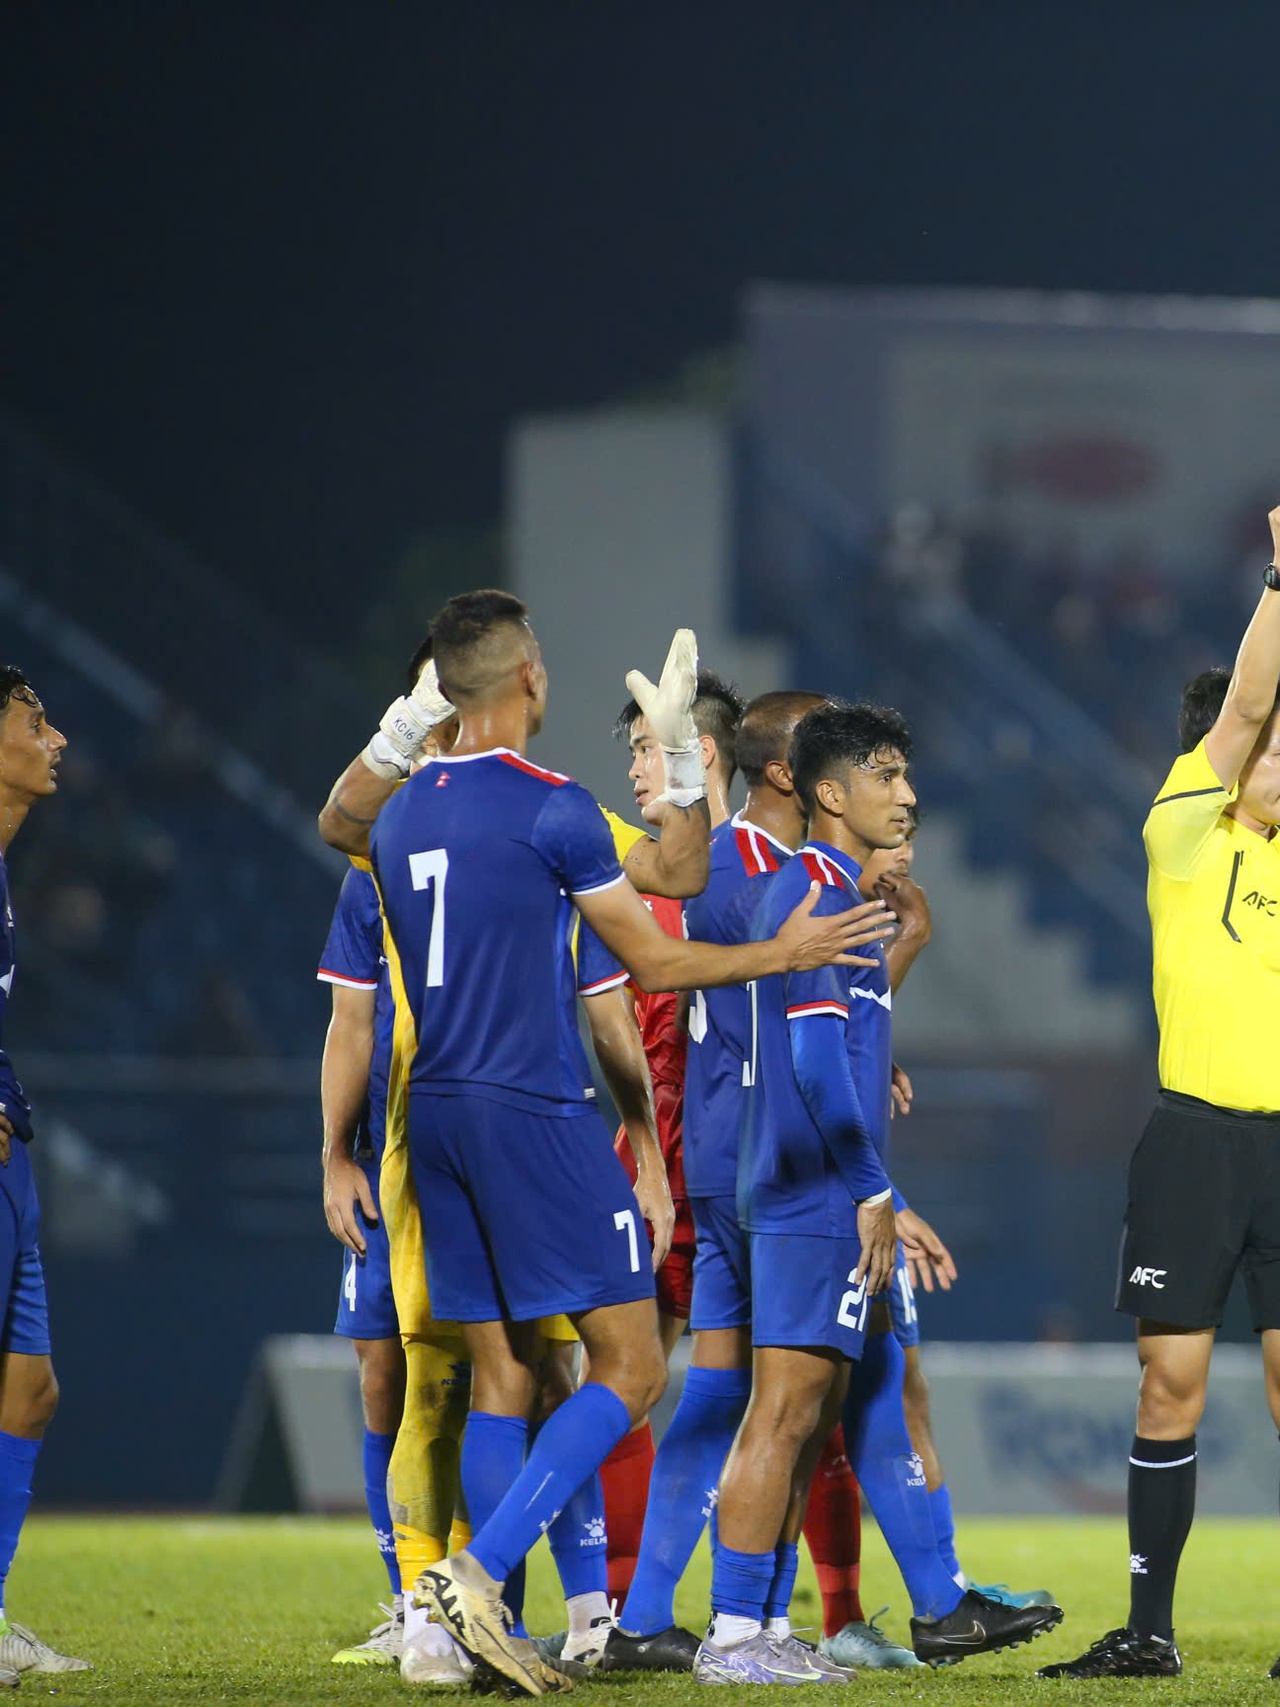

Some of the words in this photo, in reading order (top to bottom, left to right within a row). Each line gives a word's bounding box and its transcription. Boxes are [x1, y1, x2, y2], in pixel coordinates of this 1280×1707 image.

[409, 848, 449, 987] 7
[1242, 891, 1278, 917] AFC
[613, 1209, 640, 1273] 7
[344, 1253, 357, 1312] 4
[1129, 1265, 1168, 1289] AFC
